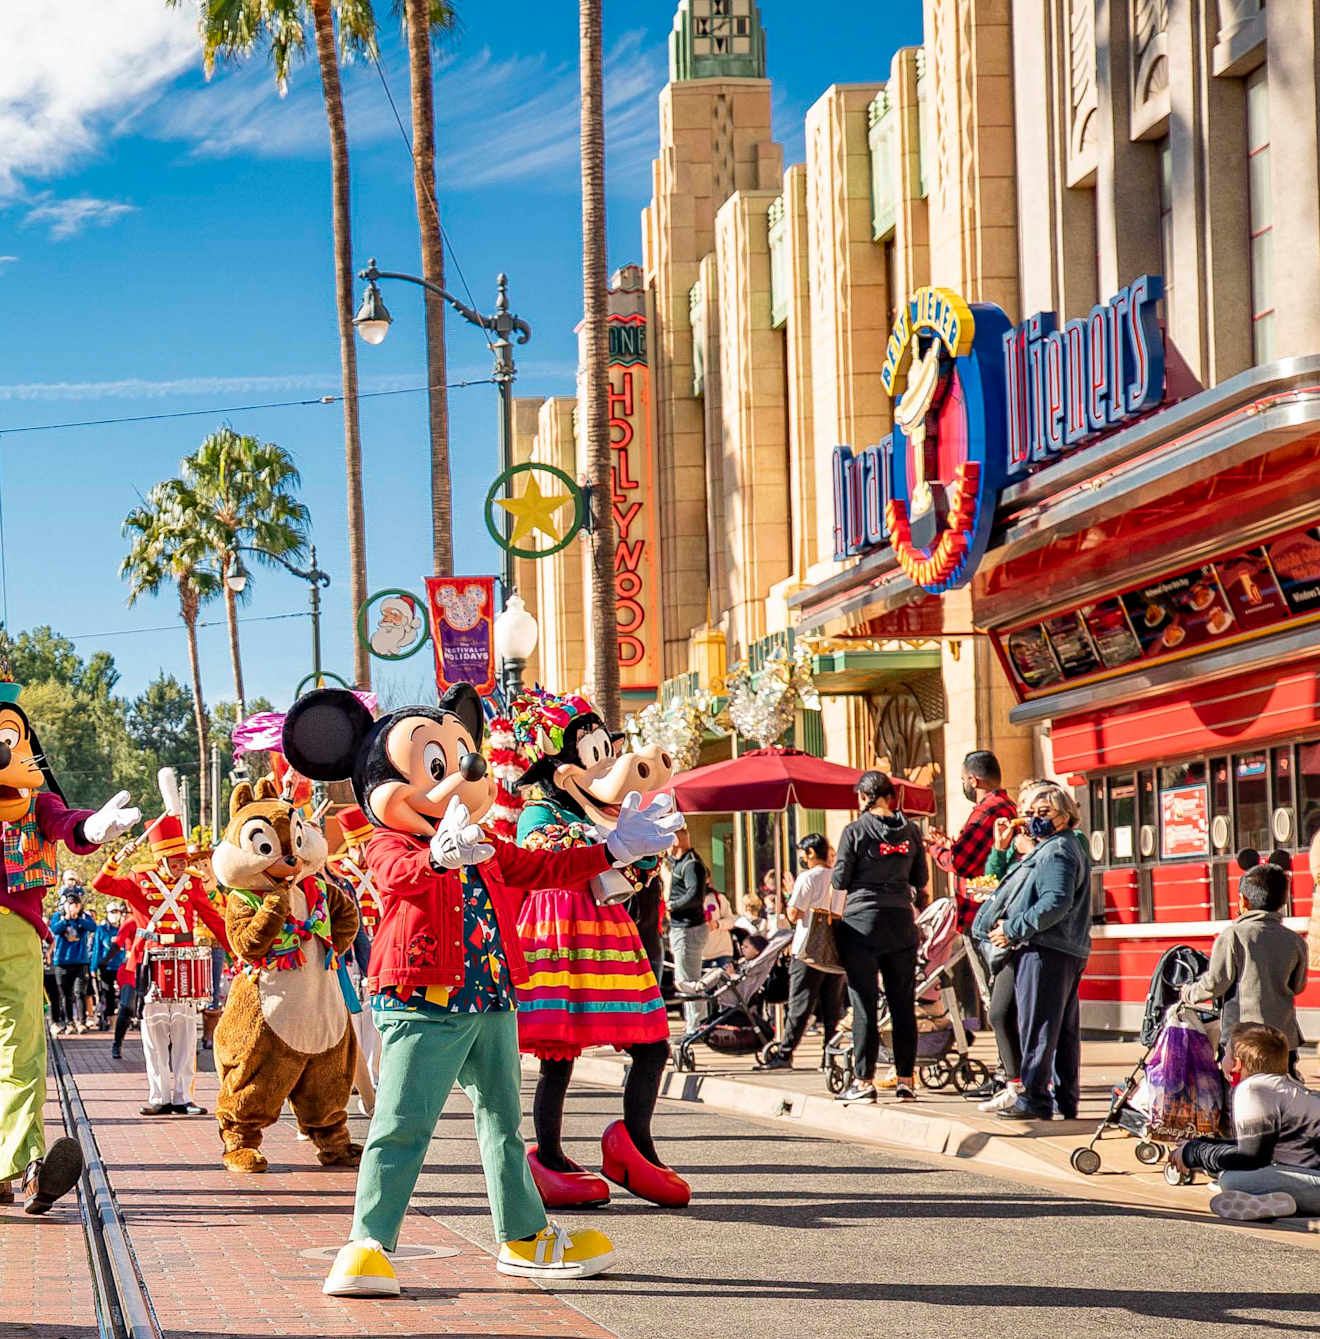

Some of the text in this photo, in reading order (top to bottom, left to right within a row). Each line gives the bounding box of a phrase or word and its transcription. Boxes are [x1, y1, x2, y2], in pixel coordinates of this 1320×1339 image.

[609, 325, 646, 355] ONE
[1003, 275, 1151, 475] Wieners
[608, 372, 644, 667] HOLLYWOOD
[832, 432, 893, 561] Awar
